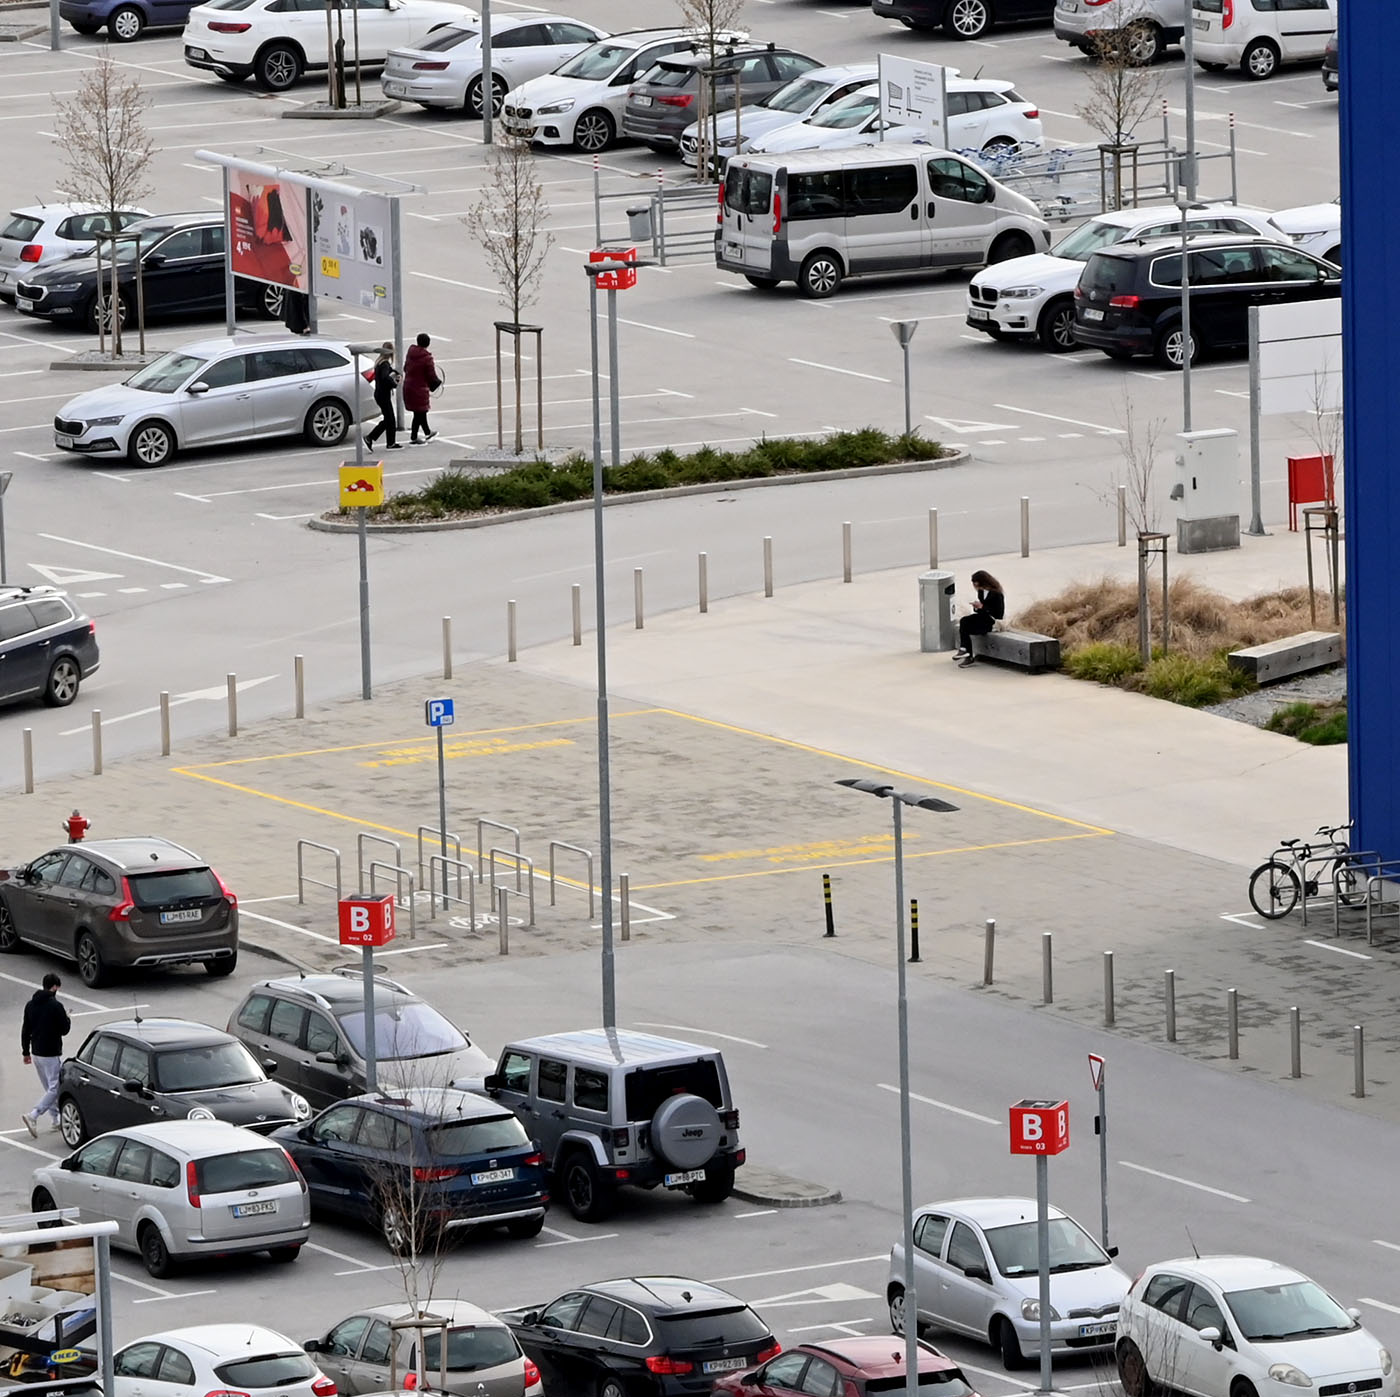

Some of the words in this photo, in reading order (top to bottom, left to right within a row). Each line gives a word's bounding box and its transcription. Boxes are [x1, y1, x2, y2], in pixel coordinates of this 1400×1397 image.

[432, 702, 444, 722] P
[350, 906, 370, 932] B
[384, 903, 392, 930] B
[363, 934, 372, 942] 02
[682, 1129, 703, 1138] Jeep
[1022, 1113, 1043, 1141] B
[1058, 1110, 1066, 1138] B
[1036, 1142, 1046, 1150] 03
